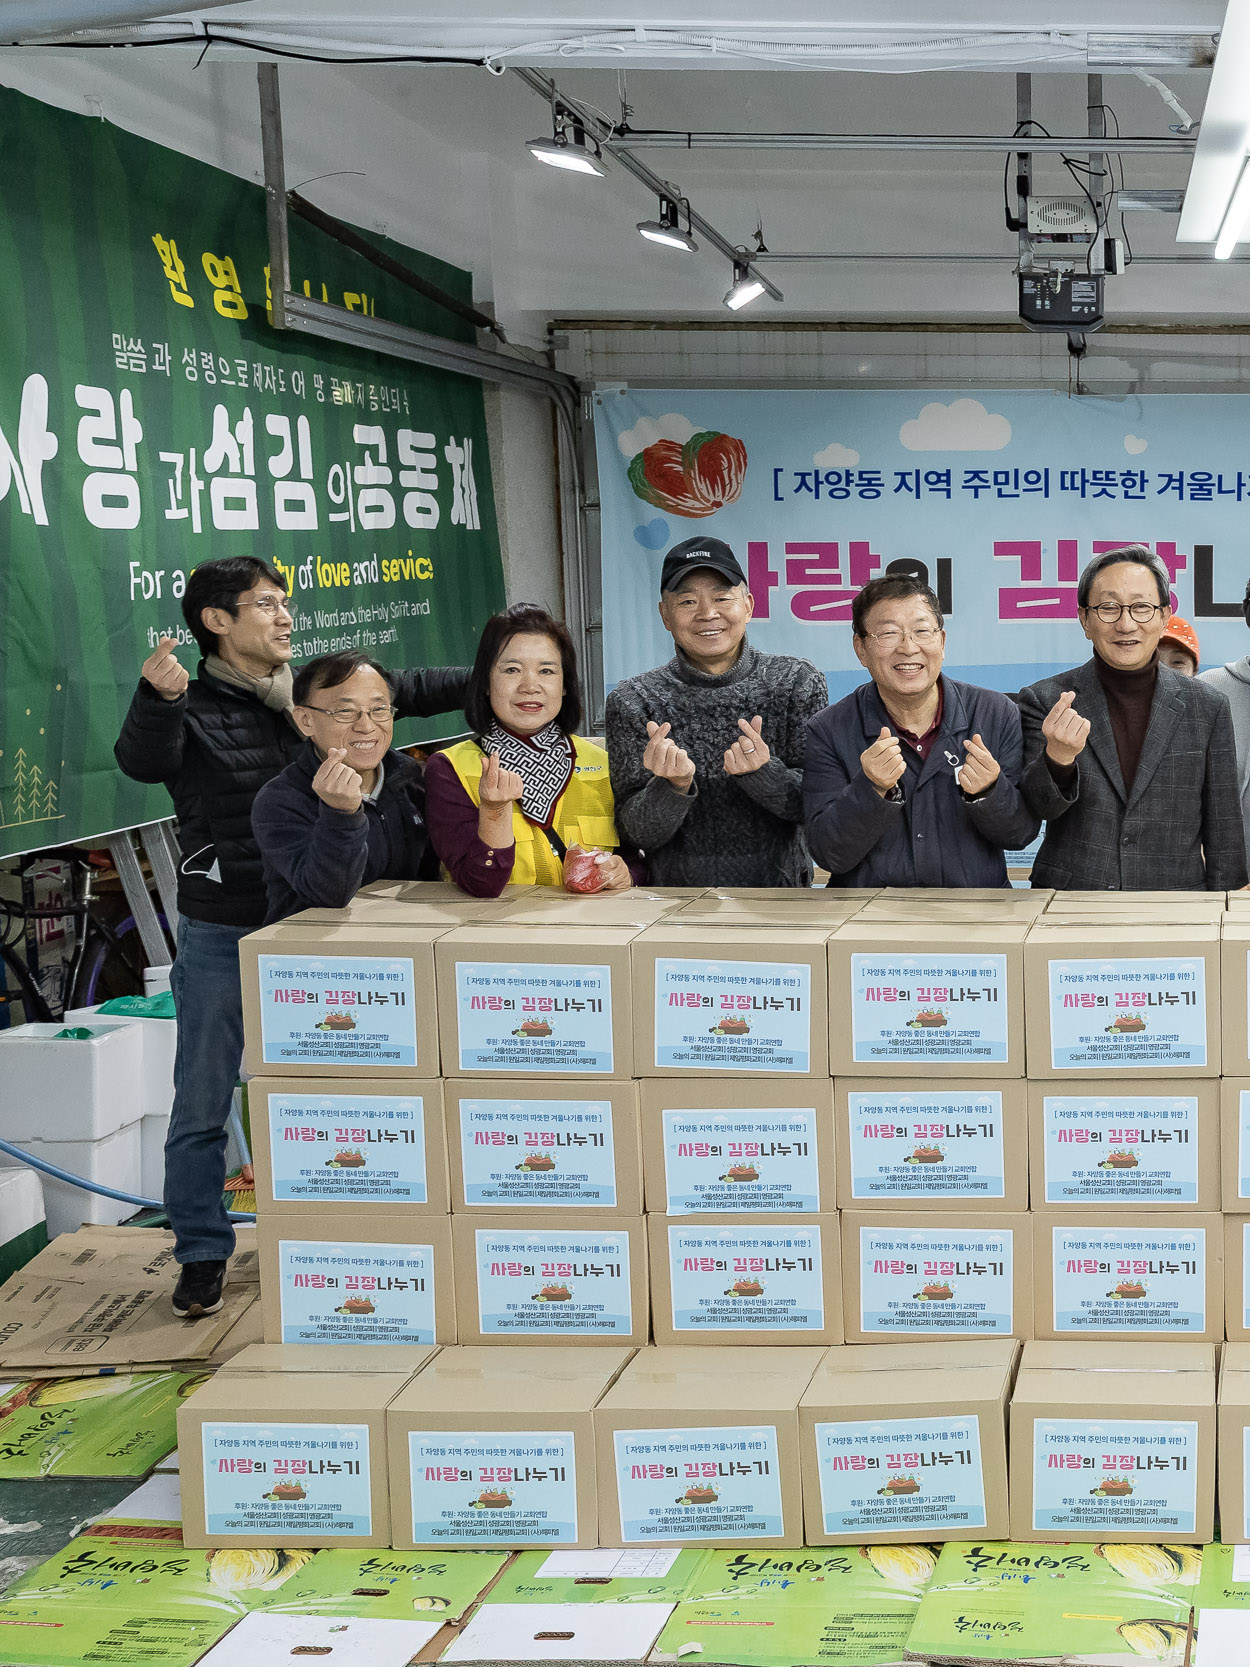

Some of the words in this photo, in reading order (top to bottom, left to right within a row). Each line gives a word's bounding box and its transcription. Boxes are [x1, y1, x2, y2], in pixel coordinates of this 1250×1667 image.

[181, 347, 249, 388] 성령으로
[203, 403, 356, 532] 섬김의
[793, 468, 885, 500] 자양동
[893, 468, 951, 500] 지역
[960, 467, 1050, 500] 주민의
[1060, 467, 1149, 501] 따뜻한
[129, 561, 162, 601] For
[298, 556, 314, 590] of
[315, 555, 350, 588] love
[743, 540, 953, 623] 랑의
[362, 628, 377, 647] the
[274, 989, 318, 1004] 사랑의
[324, 990, 405, 1006] 김장나누기
[866, 987, 910, 1001] 사랑의
[916, 987, 997, 1002] 김장나누기
[1064, 993, 1108, 1008] 사랑의
[1115, 991, 1196, 1007] 김장나누기
[471, 996, 515, 1011] 사랑의
[521, 997, 602, 1013] 김장나누기
[284, 1127, 328, 1142] 사랑의
[334, 1128, 415, 1144] 김장나누기
[1058, 1129, 1102, 1143] 사랑의
[1108, 1129, 1188, 1143] 김장나누기
[678, 1143, 722, 1157] 사랑의
[728, 1142, 808, 1157] 김장나누기
[491, 1262, 535, 1276] 사랑의
[541, 1263, 620, 1277] 김장나누기
[874, 1260, 917, 1275] 사랑의
[924, 1261, 1003, 1276] 김장나누기
[1067, 1260, 1110, 1273] 사랑의
[1117, 1260, 1196, 1274] 김장나누기
[294, 1274, 338, 1289] 사랑의
[344, 1275, 425, 1292] 김장나누기
[218, 1458, 266, 1473] 사랑의
[273, 1459, 360, 1475] 김장나누기
[833, 1455, 880, 1471] 사랑의
[885, 1450, 971, 1469] 김장나누기
[1048, 1454, 1095, 1469] 사랑의
[1101, 1455, 1187, 1471] 김장나누기
[425, 1467, 472, 1482] 사랑의
[479, 1467, 565, 1482] 김장나누기
[726, 1553, 853, 1581] 절임배추
[962, 1546, 1091, 1573] 절임배추
